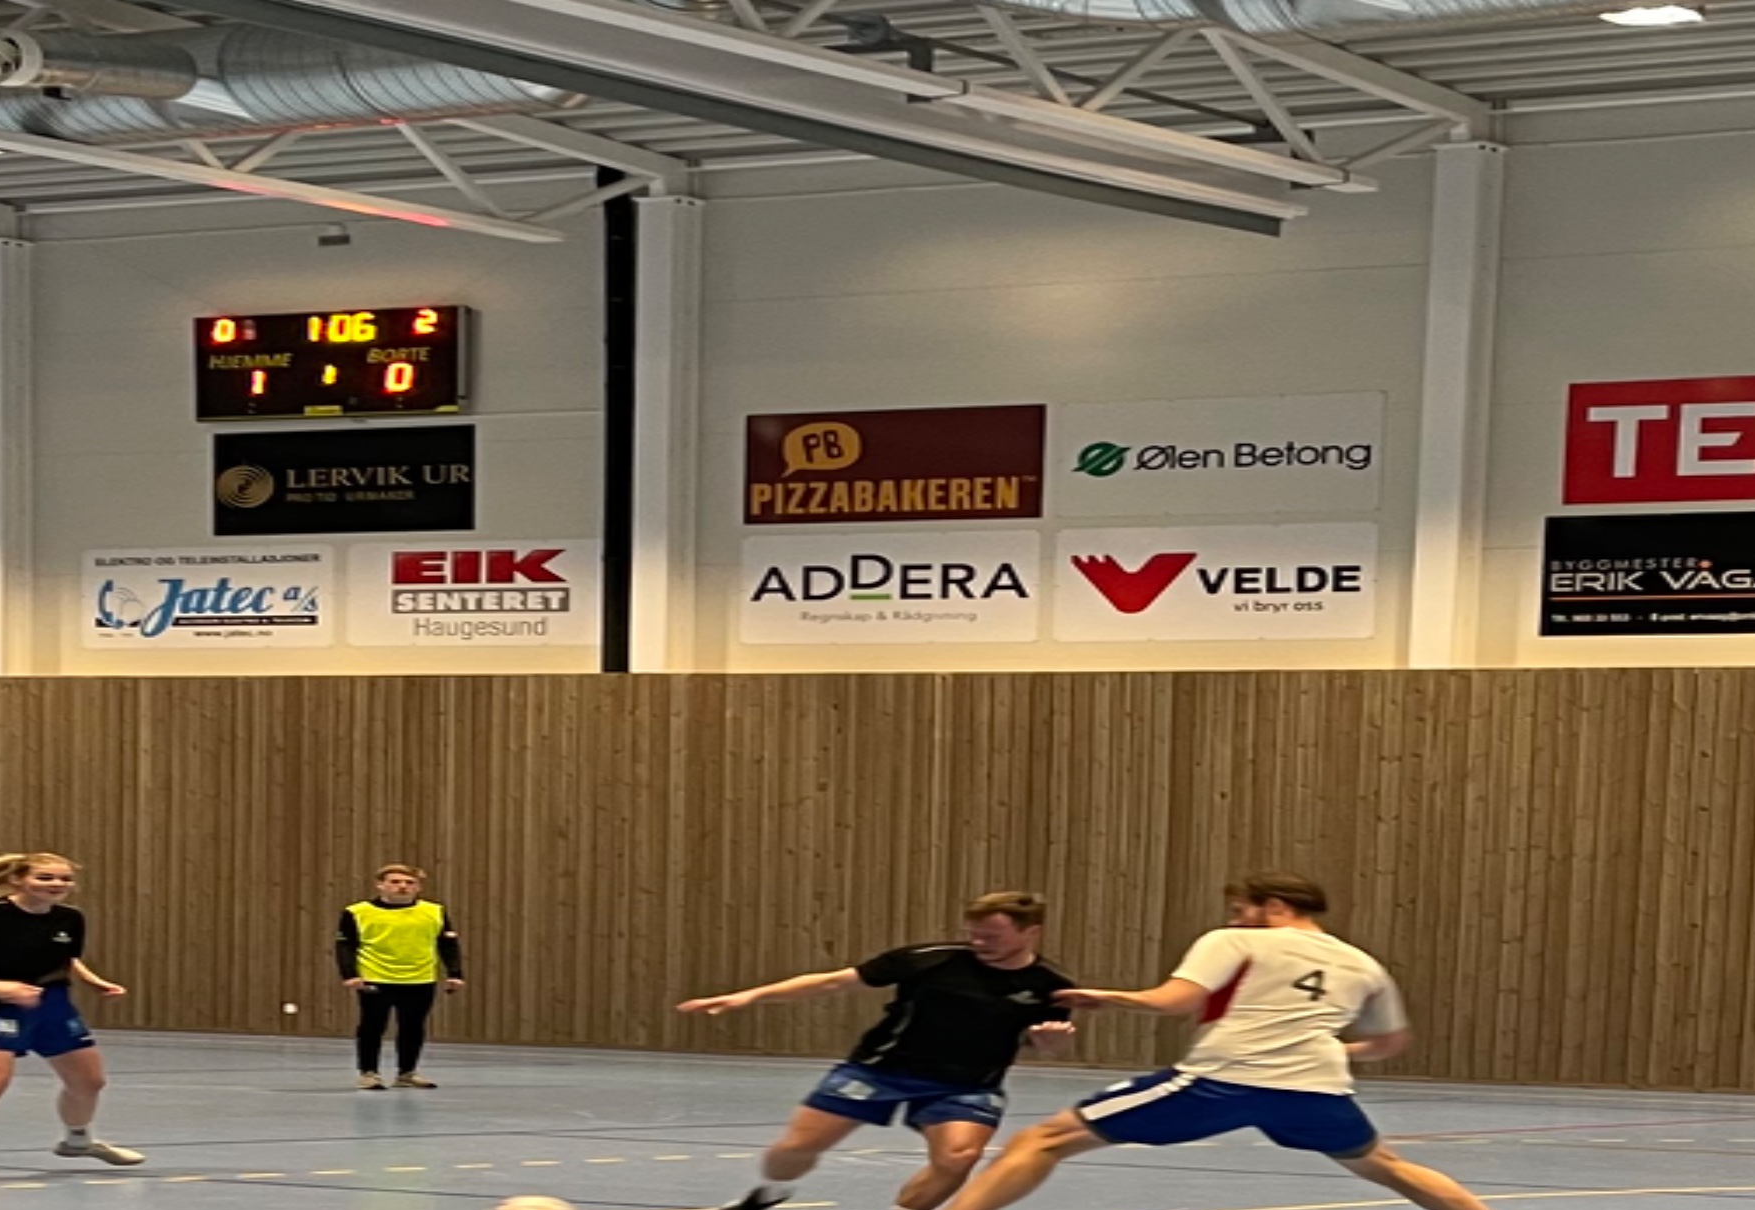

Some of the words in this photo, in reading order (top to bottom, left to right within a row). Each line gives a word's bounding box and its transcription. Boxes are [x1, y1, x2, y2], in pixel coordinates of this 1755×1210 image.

[414, 309, 438, 335] 2
[366, 347, 431, 364] BORTE
[384, 362, 414, 393] 0
[801, 429, 845, 464] PB
[1133, 443, 1226, 471] Ølen
[1234, 440, 1373, 471] Betong
[286, 465, 414, 488] LERVIK
[421, 463, 471, 485] UR
[750, 475, 1021, 515] PIZZABAKEREN
[392, 548, 568, 585] EIK
[750, 554, 1030, 602] ADDERA
[1550, 557, 1698, 572] BYGGMESTER
[1196, 565, 1362, 595] VELDE
[1550, 571, 1644, 593] ERIK
[140, 577, 276, 638] Jatec
[396, 590, 566, 611] SENTERET
[412, 617, 549, 640] Haugesund
[1290, 968, 1327, 1002] 4
